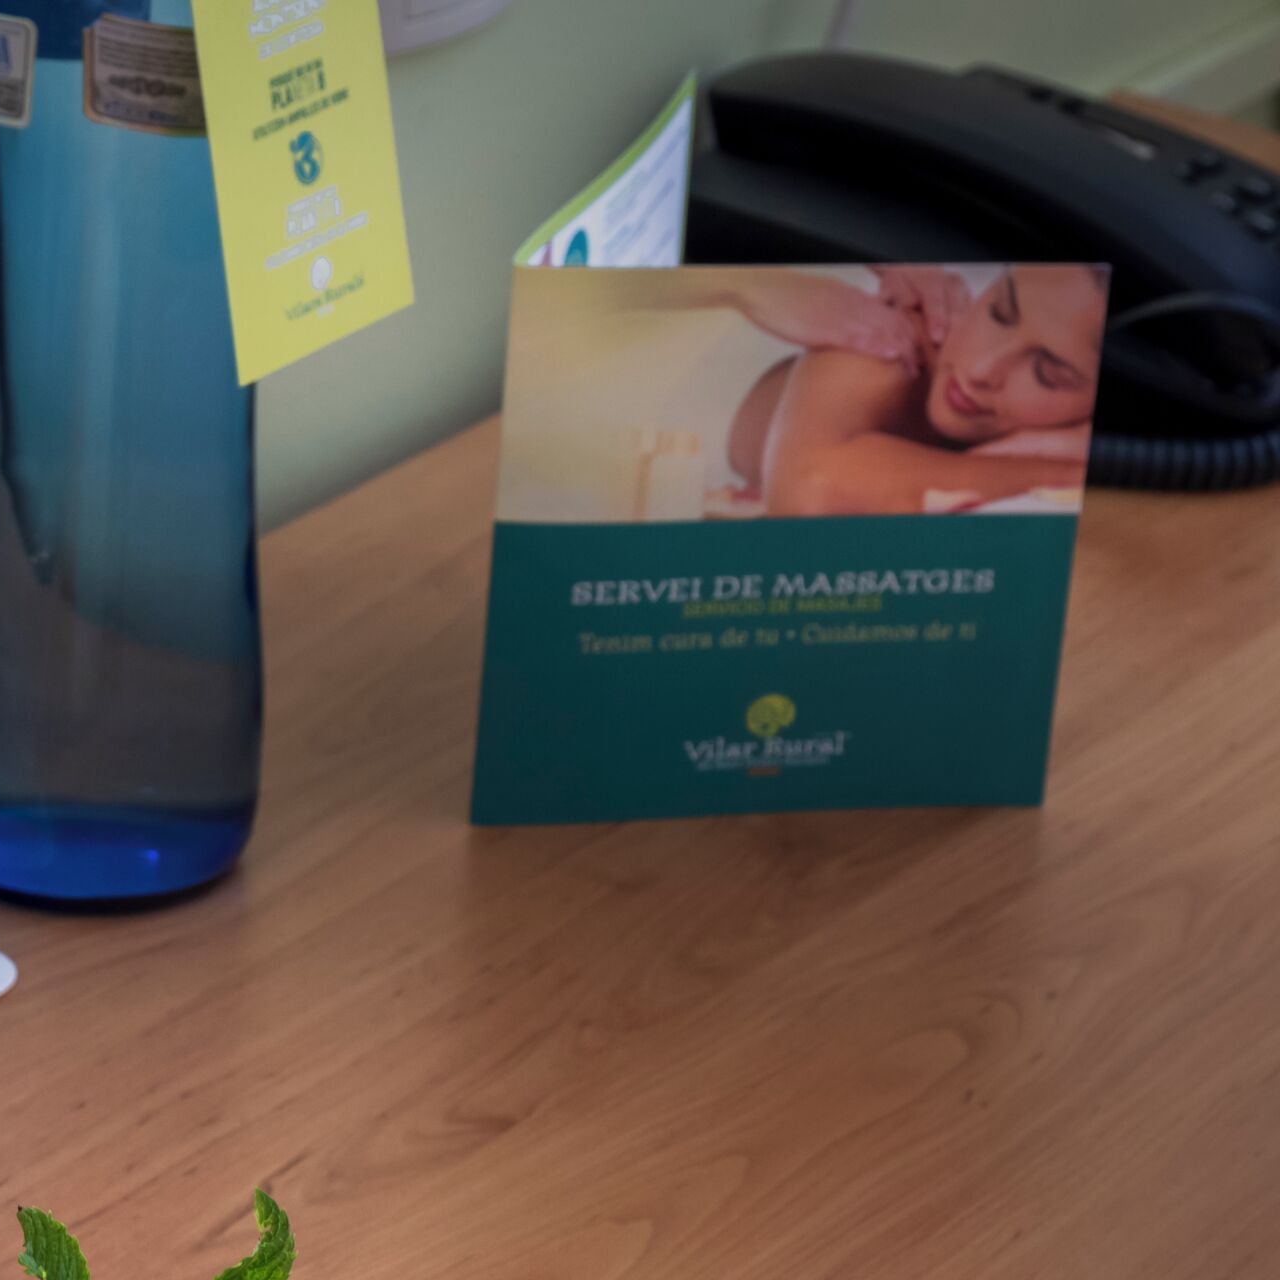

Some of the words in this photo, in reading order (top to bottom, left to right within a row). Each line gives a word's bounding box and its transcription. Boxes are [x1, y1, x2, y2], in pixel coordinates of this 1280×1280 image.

[571, 576, 704, 607] SERVEI
[713, 573, 764, 600] DE
[772, 568, 995, 597] MASSATGES
[578, 632, 652, 655] Tenim
[659, 633, 713, 650] cura
[720, 627, 748, 648] de
[802, 622, 919, 644] Cuidamos
[923, 618, 953, 641] de
[683, 735, 758, 760] Vilar
[764, 730, 845, 756] Rural
